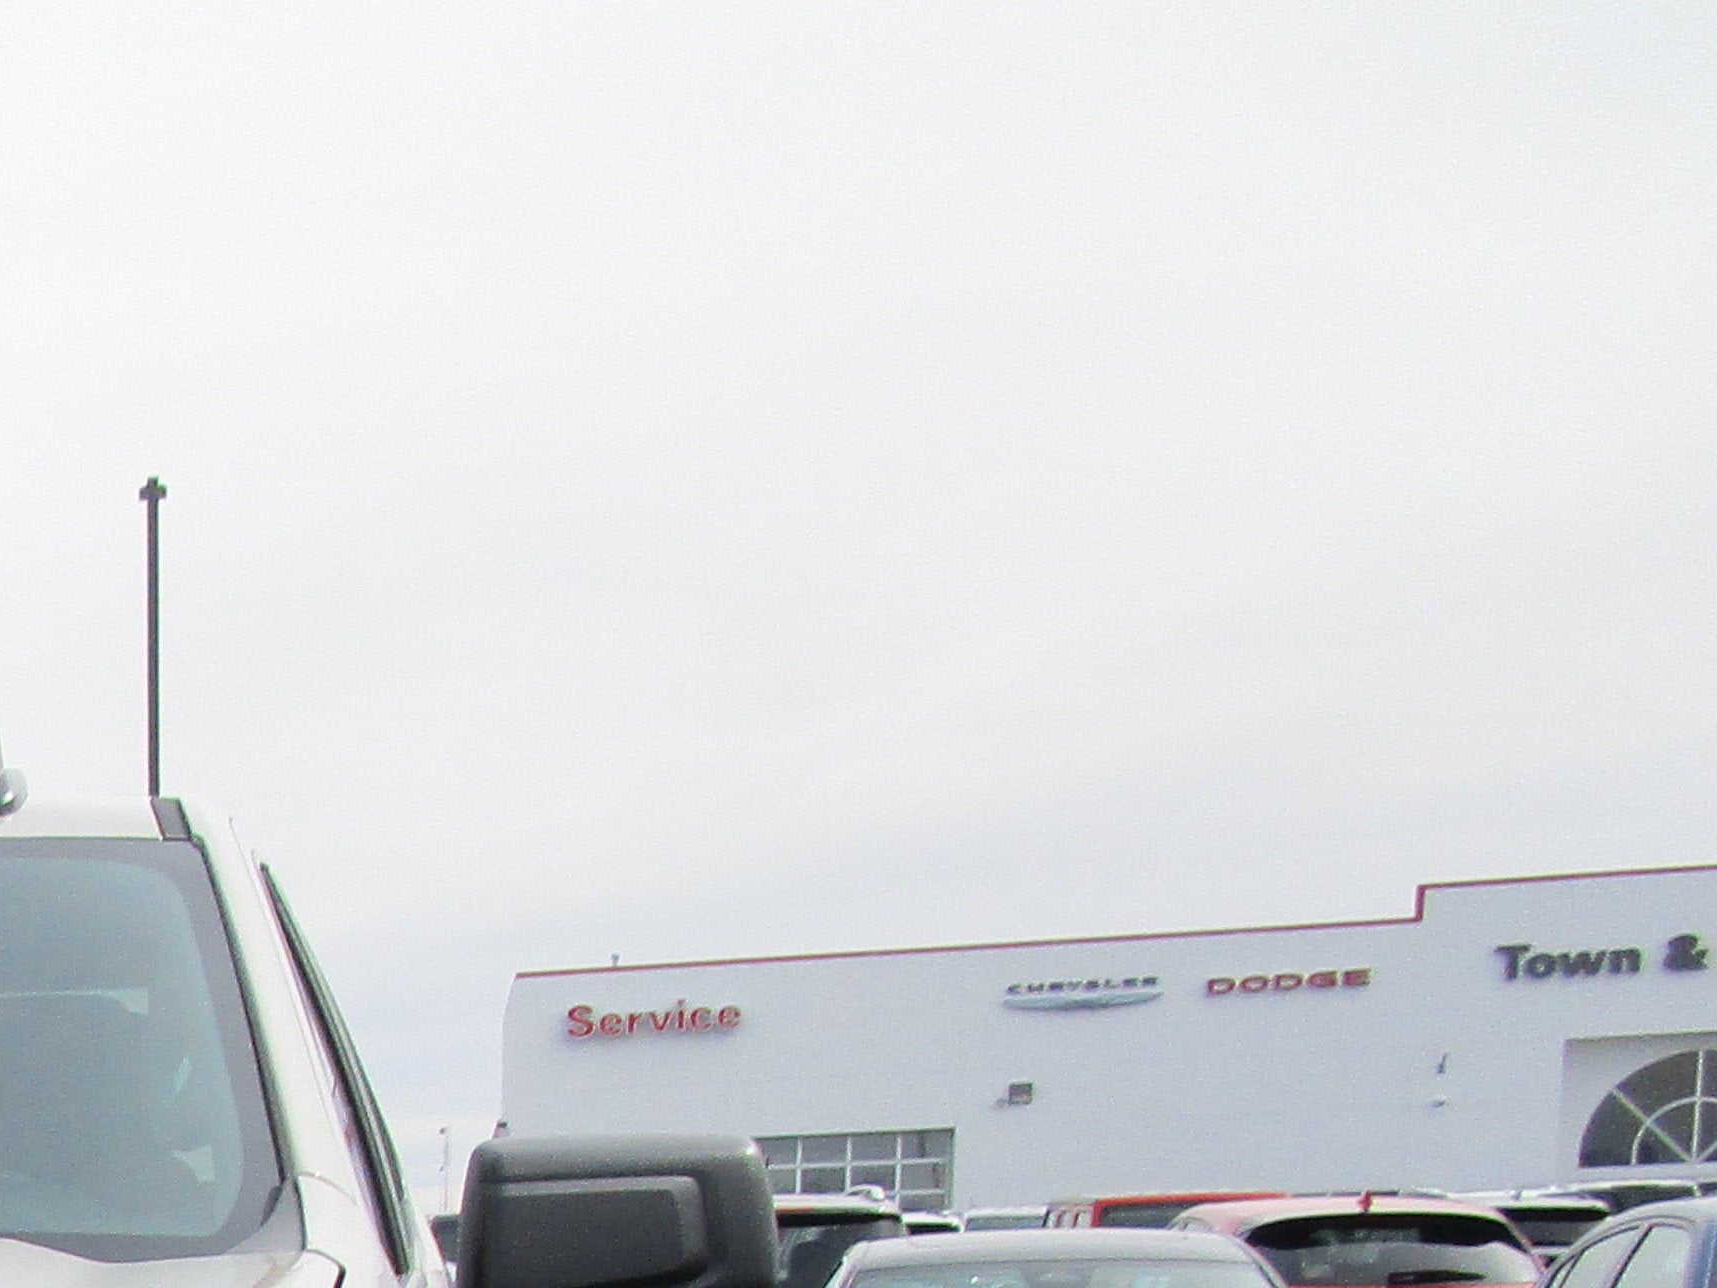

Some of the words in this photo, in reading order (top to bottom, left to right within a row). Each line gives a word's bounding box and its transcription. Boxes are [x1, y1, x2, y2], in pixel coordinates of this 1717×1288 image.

[1494, 943, 1642, 981] Town
[1664, 932, 1710, 971] &
[1207, 967, 1371, 996] DODGE
[567, 999, 743, 1038] Service
